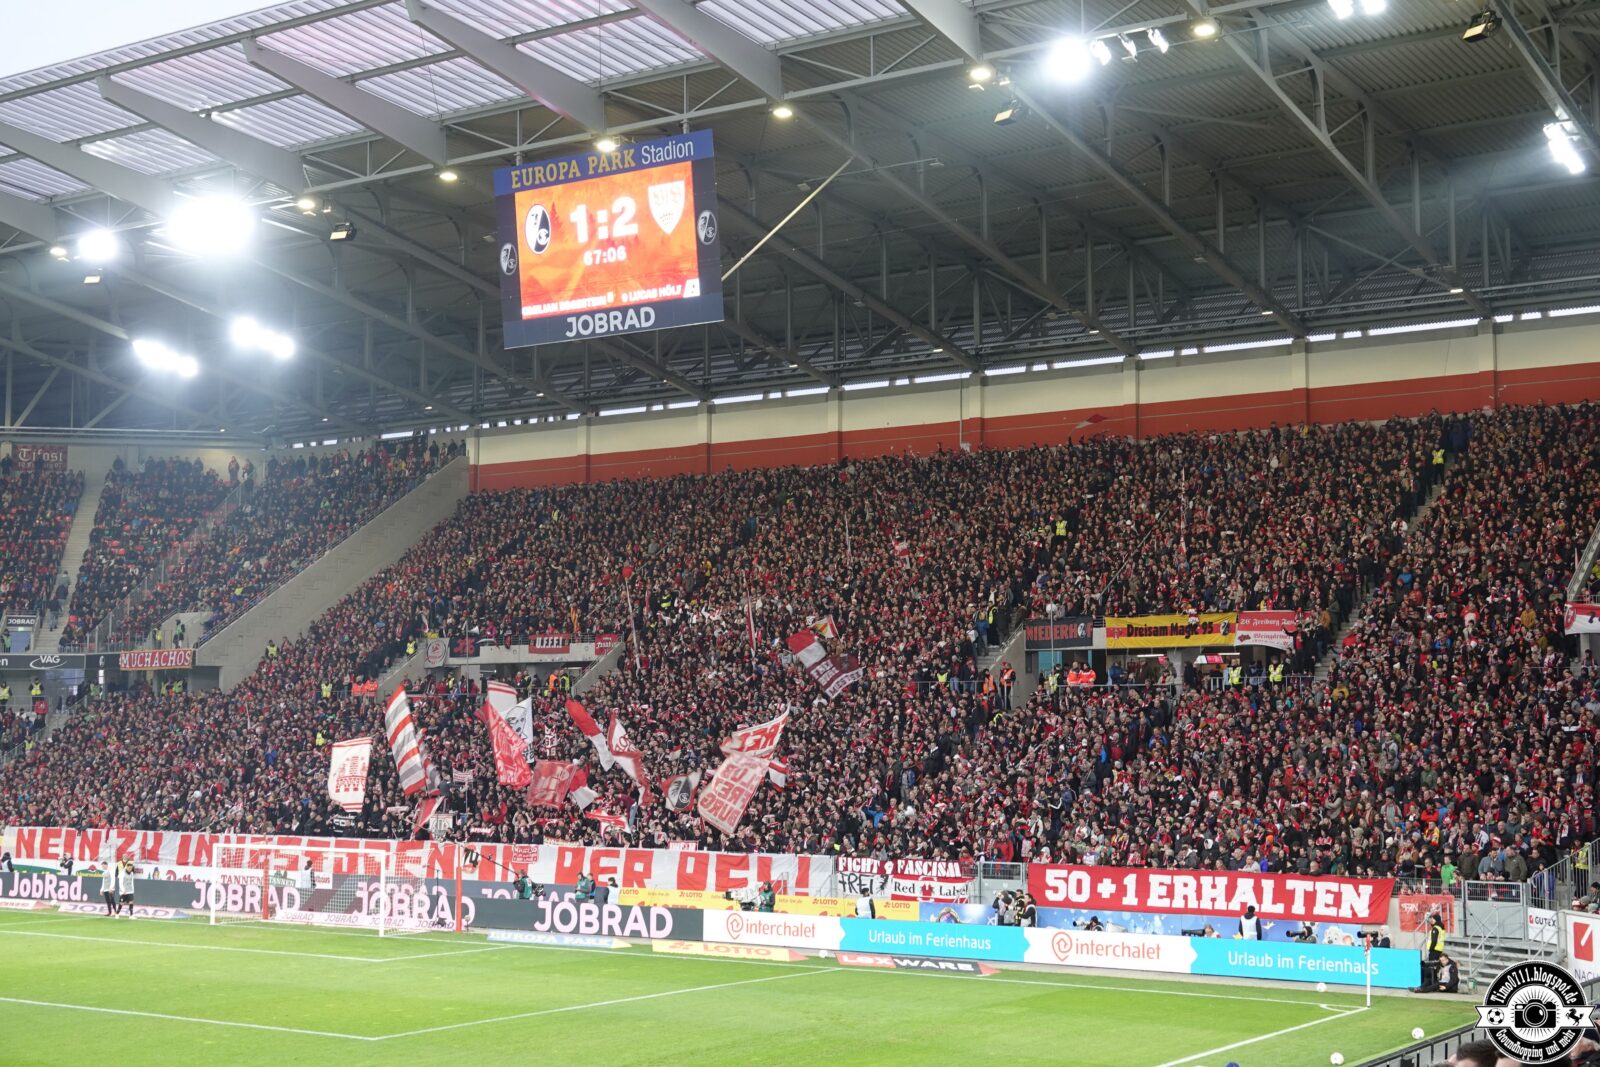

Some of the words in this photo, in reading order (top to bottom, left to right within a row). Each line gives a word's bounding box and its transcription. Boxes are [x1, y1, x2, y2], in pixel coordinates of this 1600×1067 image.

[511, 160, 581, 189] EUROPA
[587, 149, 636, 176] PARK
[641, 141, 694, 165] Stadion
[570, 196, 638, 243] 1:2
[583, 246, 627, 266] 67:06
[565, 306, 656, 338] JOBRAD
[1126, 624, 1168, 637] Dreisam
[1202, 621, 1214, 635] 95
[39, 655, 61, 664] VAG
[120, 651, 191, 668] MUCHACHOS
[15, 828, 102, 861] NEIN
[116, 830, 163, 862] ZU
[554, 846, 654, 888] DER
[838, 857, 881, 873] FIGHT
[897, 859, 961, 878] FASCISM
[9, 872, 88, 901] JobRad.
[192, 881, 301, 913] JOBRAD
[894, 881, 915, 894] Red
[1147, 874, 1374, 919] ERHALTEN
[352, 891, 476, 926] JOBRAD
[534, 900, 673, 939] JOBRAD
[745, 918, 816, 938] interchalet
[1535, 916, 1556, 927] GUTEX
[703, 945, 772, 956] LOTTO
[868, 929, 906, 945] Urlaub
[908, 932, 923, 947] im
[926, 932, 991, 951] Ferienhaus
[1075, 937, 1162, 961] interchalet
[1228, 950, 1273, 968] Urlaub
[1276, 953, 1294, 970] im
[1298, 955, 1380, 976] Ferienhaus
